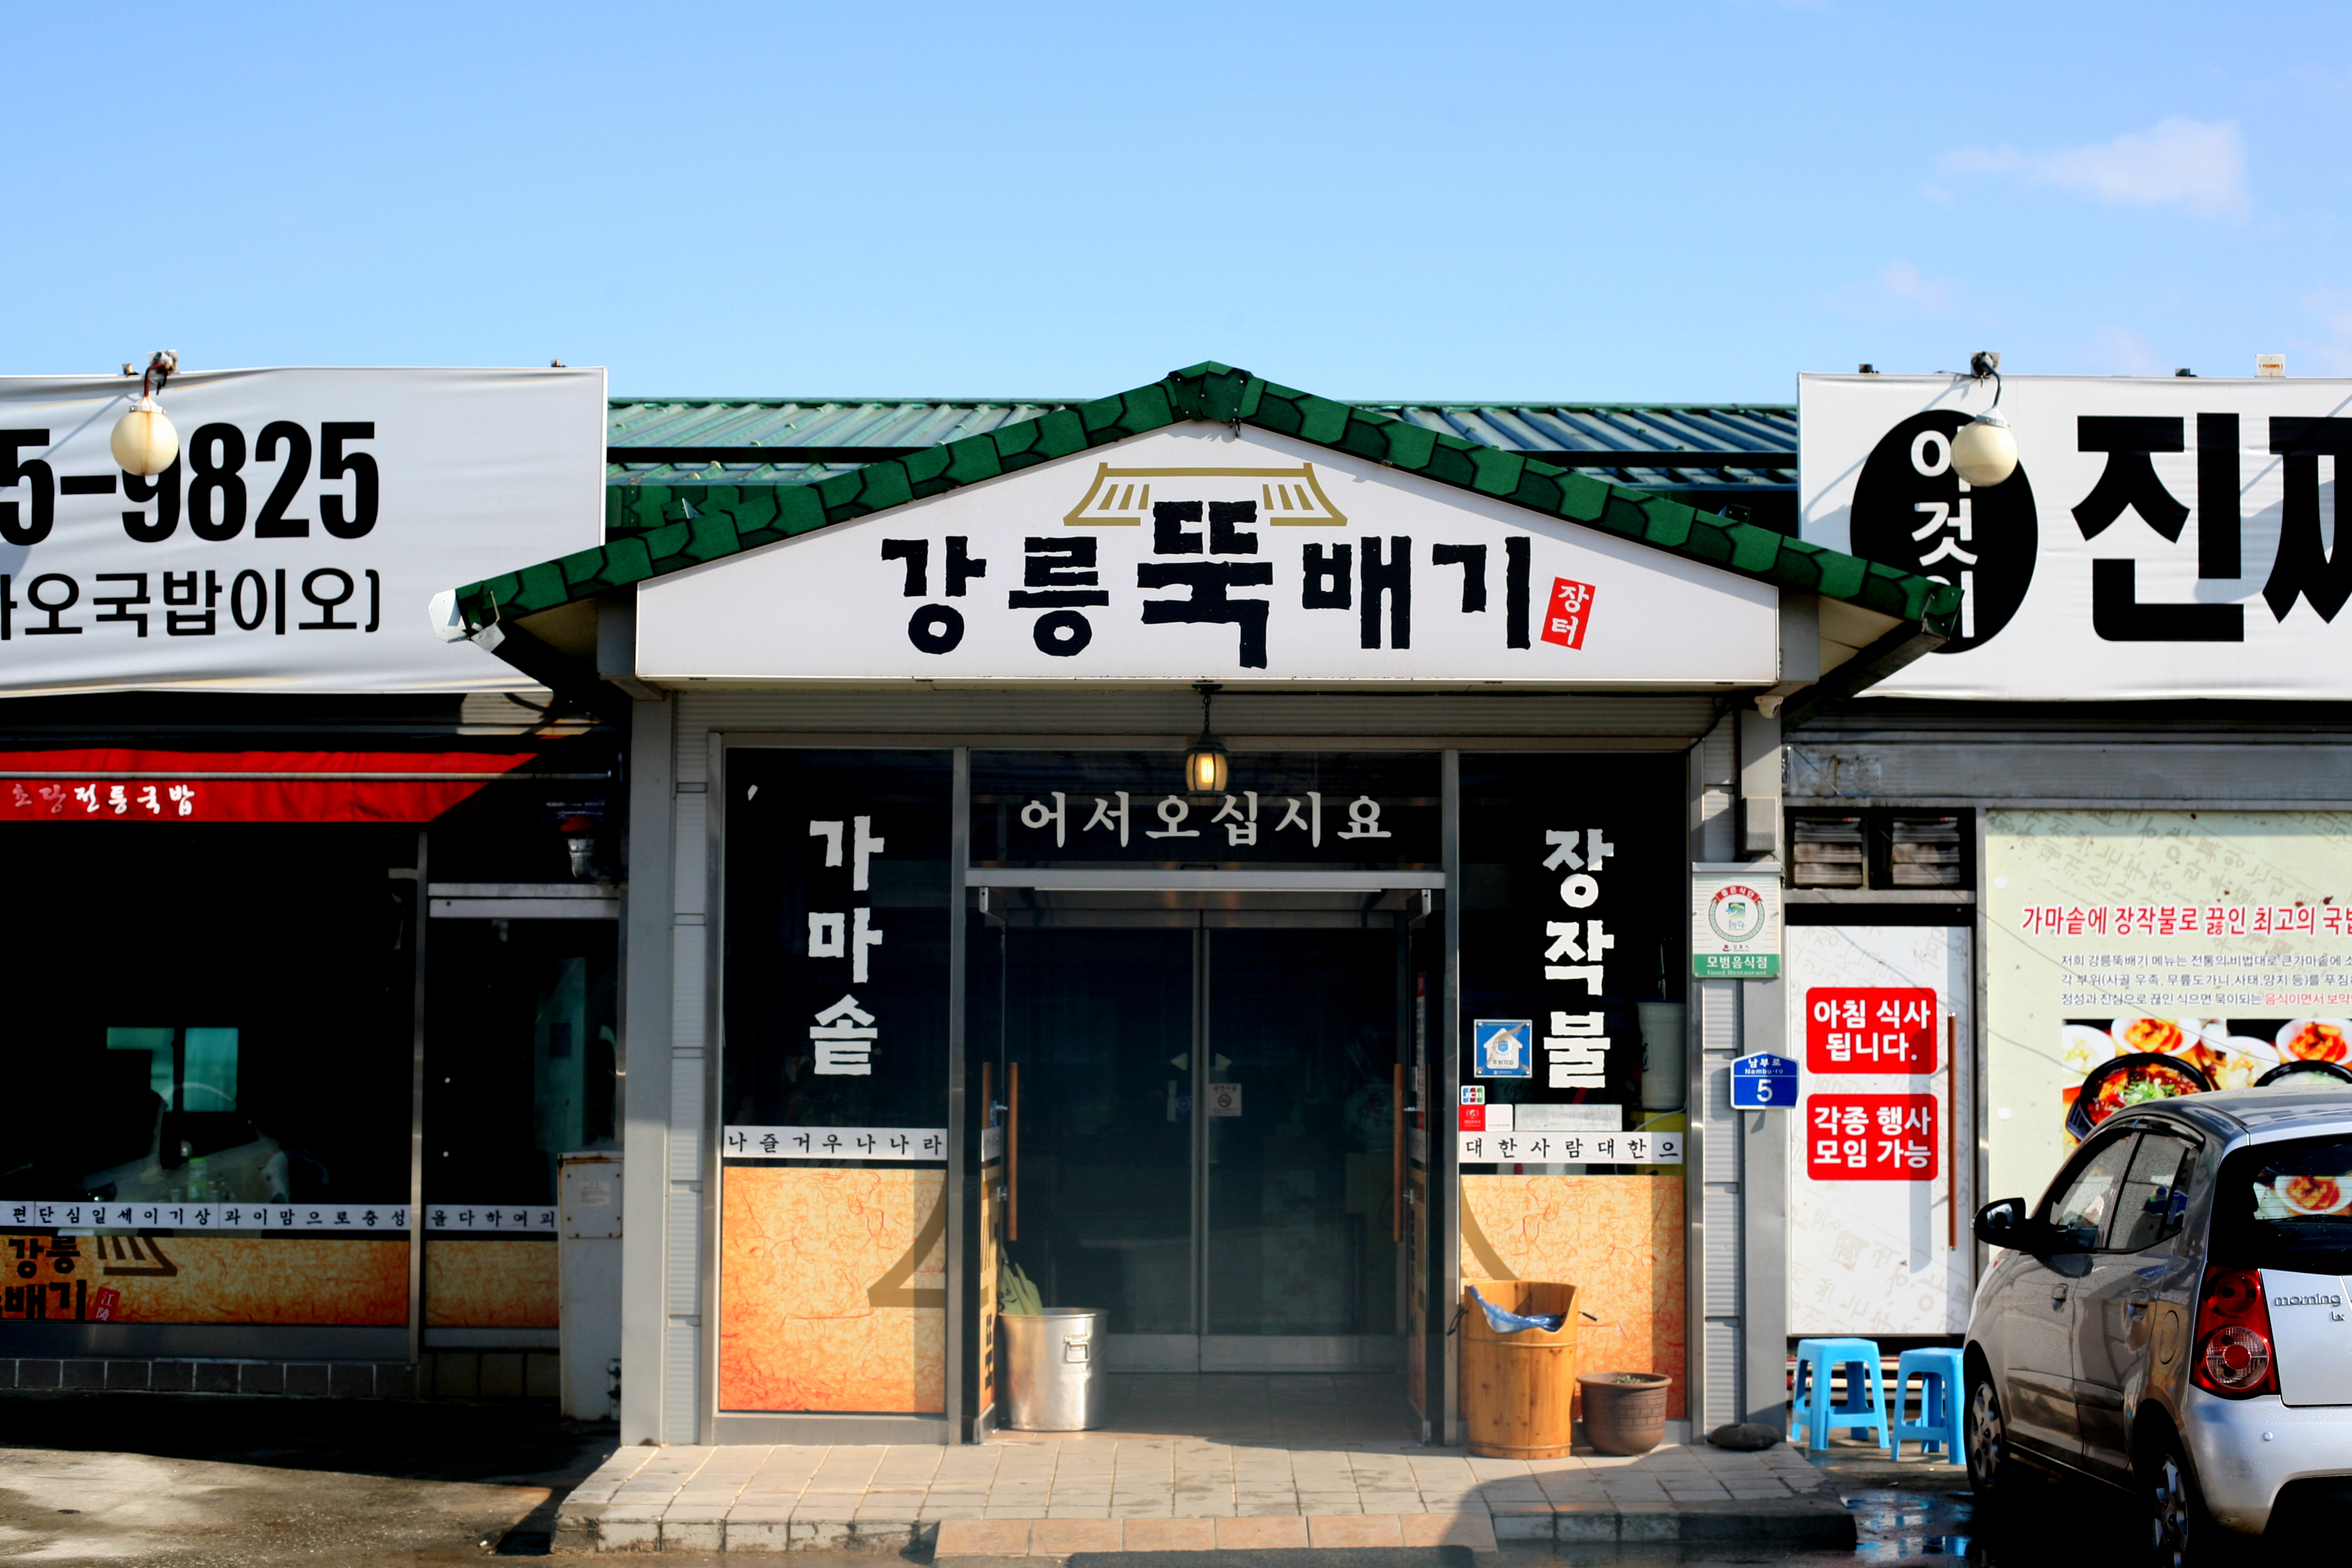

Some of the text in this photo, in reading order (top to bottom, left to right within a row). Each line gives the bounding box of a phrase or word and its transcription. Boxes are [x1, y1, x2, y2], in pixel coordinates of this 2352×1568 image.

[1550, 583, 1590, 647] 장터
[2023, 907, 2107, 935] 가마솥에
[2115, 907, 2198, 935] 장작불로
[2206, 907, 2245, 935] 끓인
[2253, 907, 2316, 935] 최고의
[809, 816, 885, 1075] 가마솥
[1543, 829, 1614, 1088] 장작불
[1707, 956, 1768, 969] 모범음식점
[2061, 955, 2084, 967] 저희
[2088, 955, 2148, 967] 강릉뚝배기
[2152, 955, 2187, 967] 메뉴는
[2062, 974, 2072, 986] 각
[2324, 974, 2352, 986] 푸짐
[1814, 1000, 1931, 1029] 아침 식사
[2062, 994, 2096, 1005] 정성과
[2265, 994, 2324, 1006] 음식이면서
[2326, 994, 2352, 1005] 보약
[1825, 1033, 1918, 1062] 됩니다.
[1748, 1058, 1781, 1068] 남부로
[1757, 1078, 1773, 1102] 5
[1814, 1106, 1932, 1136] 각종 행사
[1813, 1139, 1932, 1169] 모임 가능
[8, 1236, 80, 1279] 강릉
[0, 1279, 86, 1320] 배기
[2274, 1292, 2343, 1307] morning
